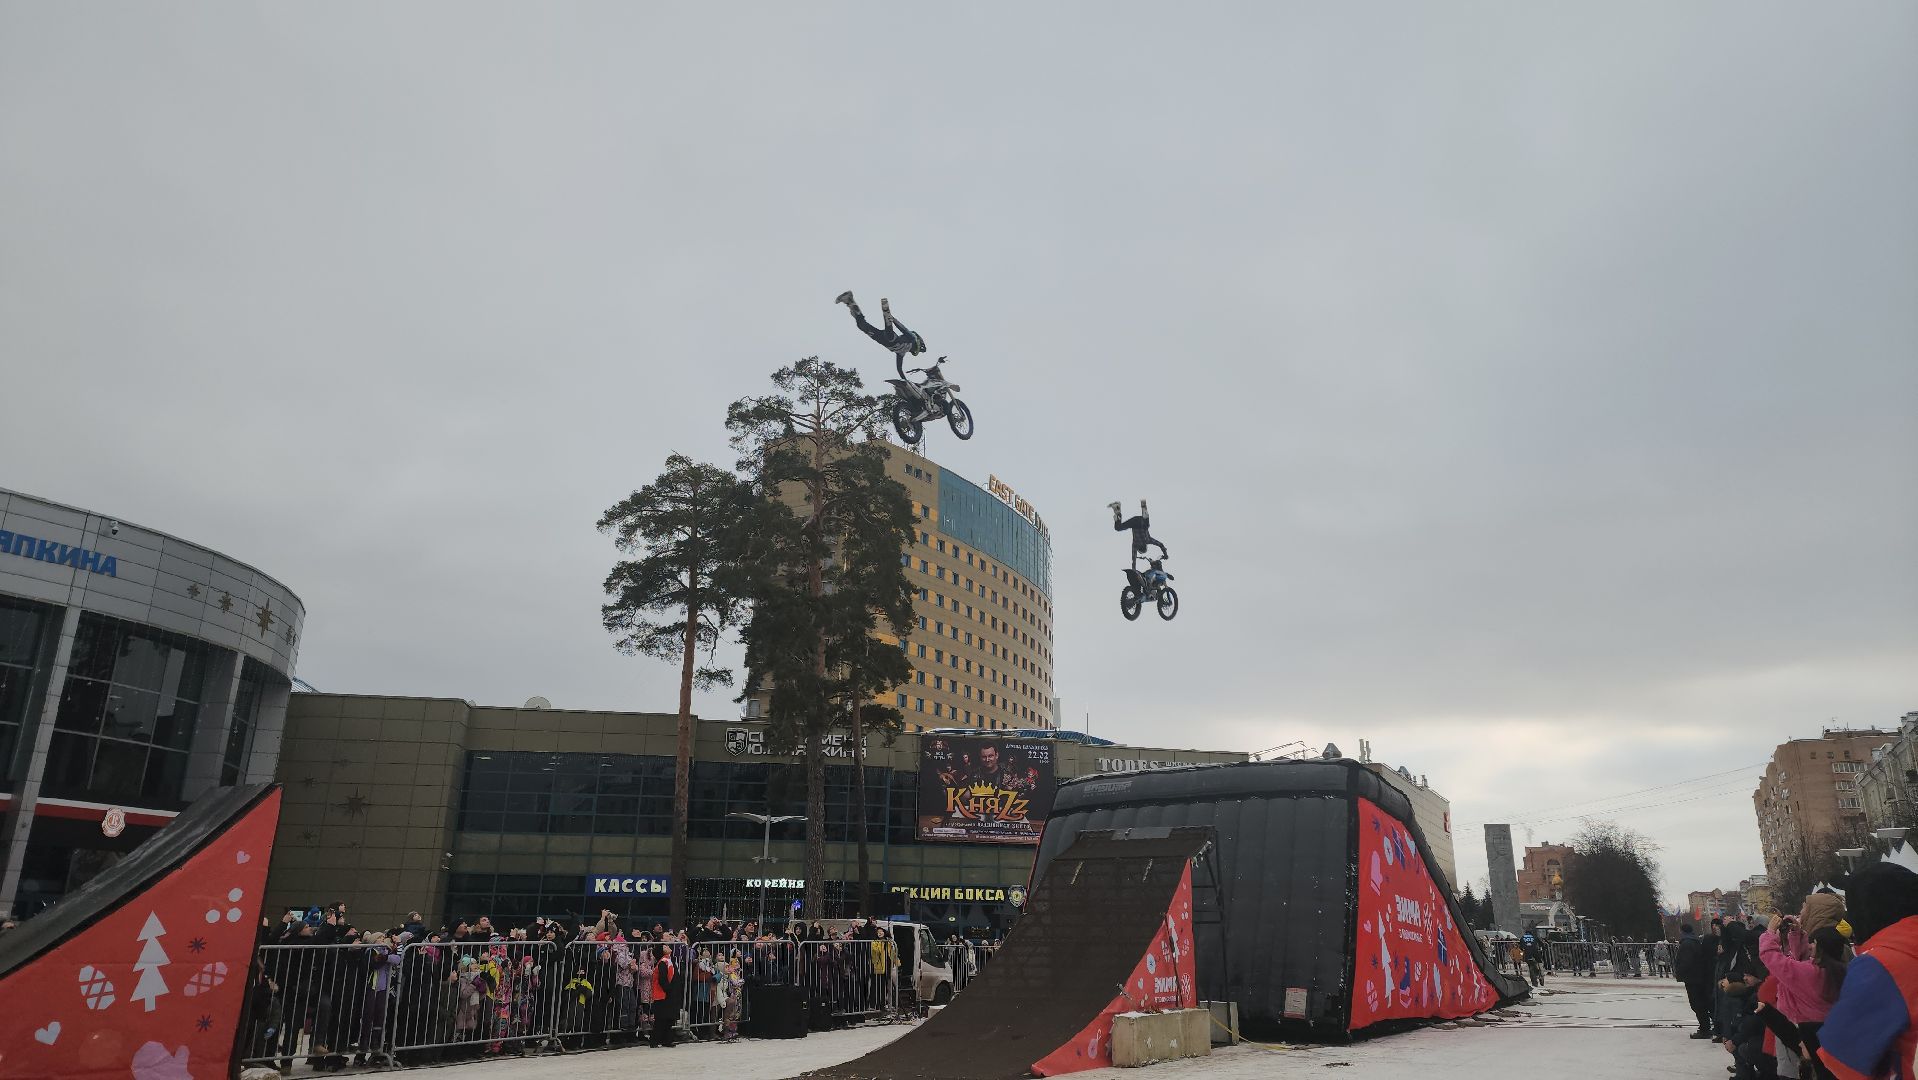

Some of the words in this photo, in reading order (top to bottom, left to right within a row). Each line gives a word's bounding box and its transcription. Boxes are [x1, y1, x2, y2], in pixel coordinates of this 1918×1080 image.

[989, 474, 1014, 503] EAST
[1015, 494, 1035, 523] GATE
[1097, 757, 1159, 773] TODES
[594, 878, 667, 894] КАССЫ
[745, 878, 805, 889] КОФЕЙНЯ
[891, 886, 951, 900] КЦИЯ
[954, 888, 1005, 901] БОКСА
